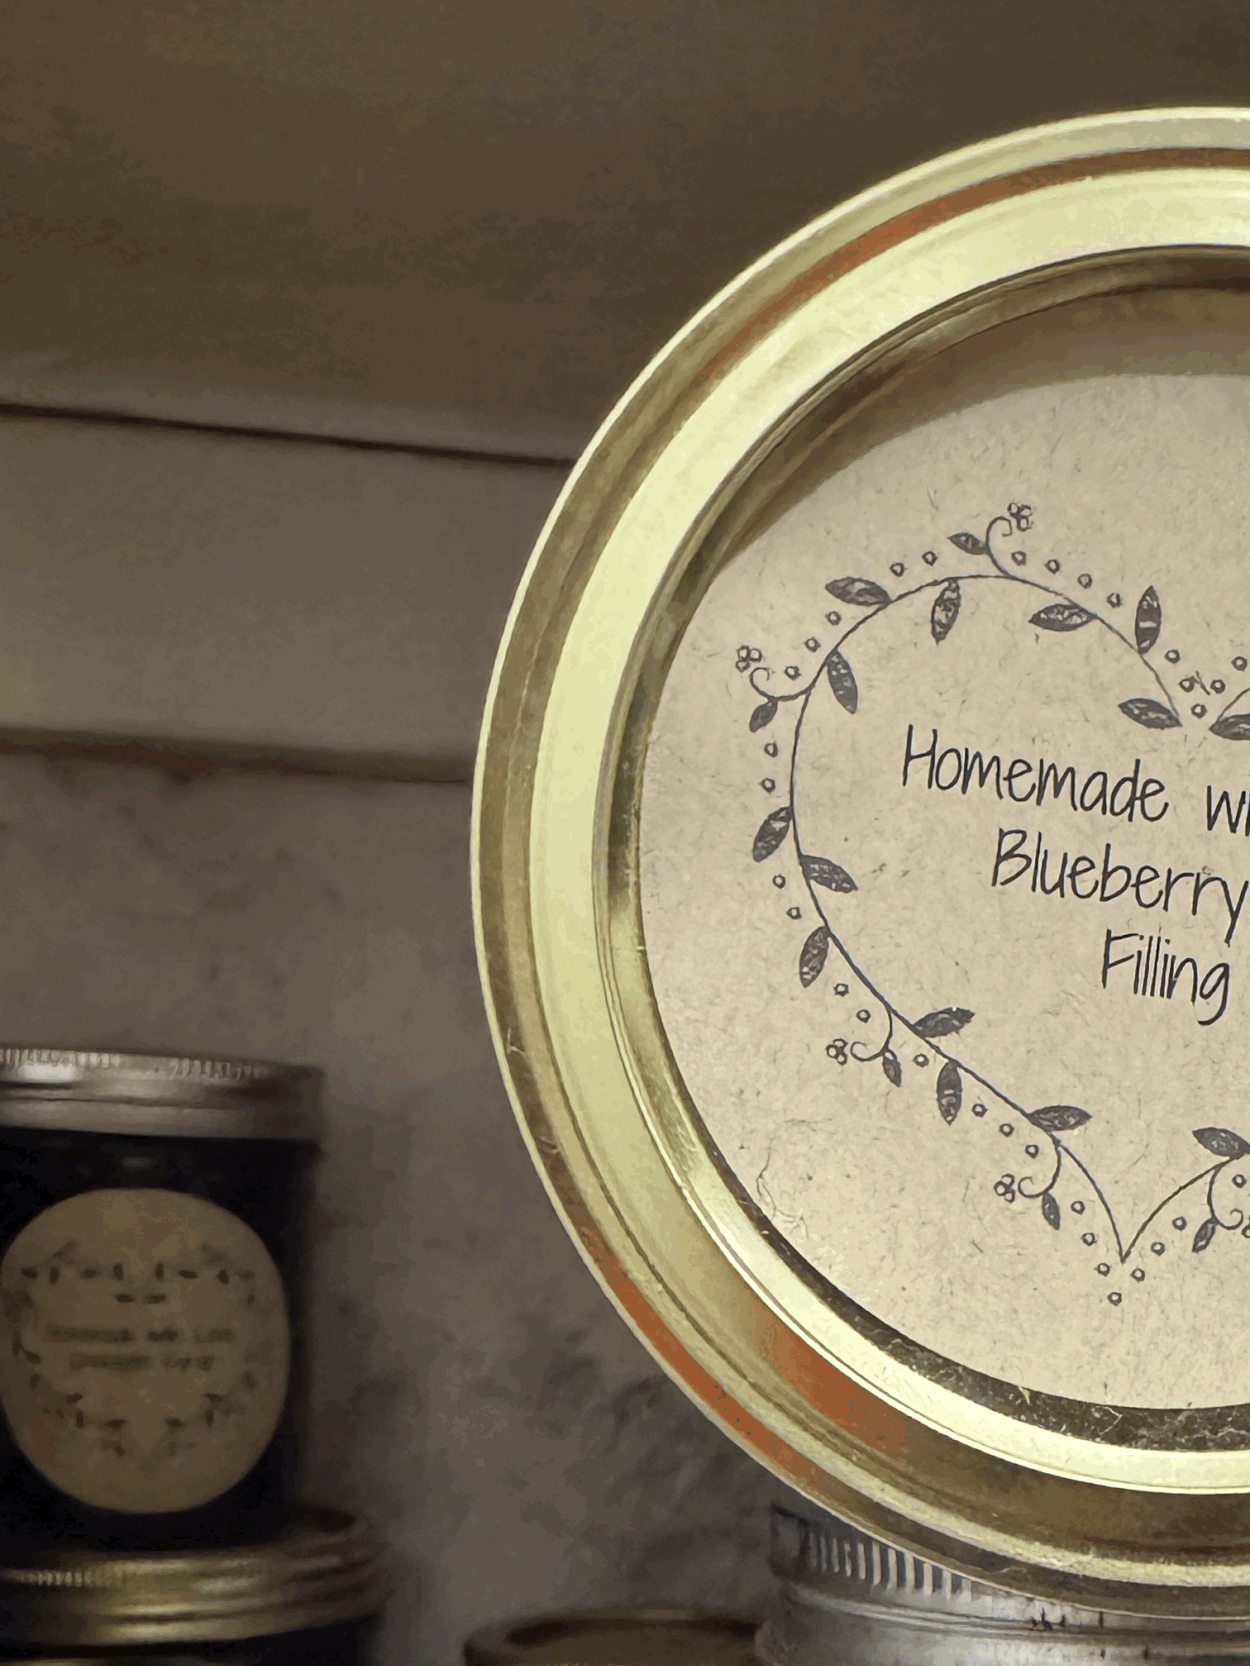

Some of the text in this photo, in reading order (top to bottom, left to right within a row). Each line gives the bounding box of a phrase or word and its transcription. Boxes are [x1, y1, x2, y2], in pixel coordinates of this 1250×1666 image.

[902, 723, 1170, 823] Homemade
[991, 827, 1250, 948] Blueberry
[1101, 928, 1230, 1026] Filling
